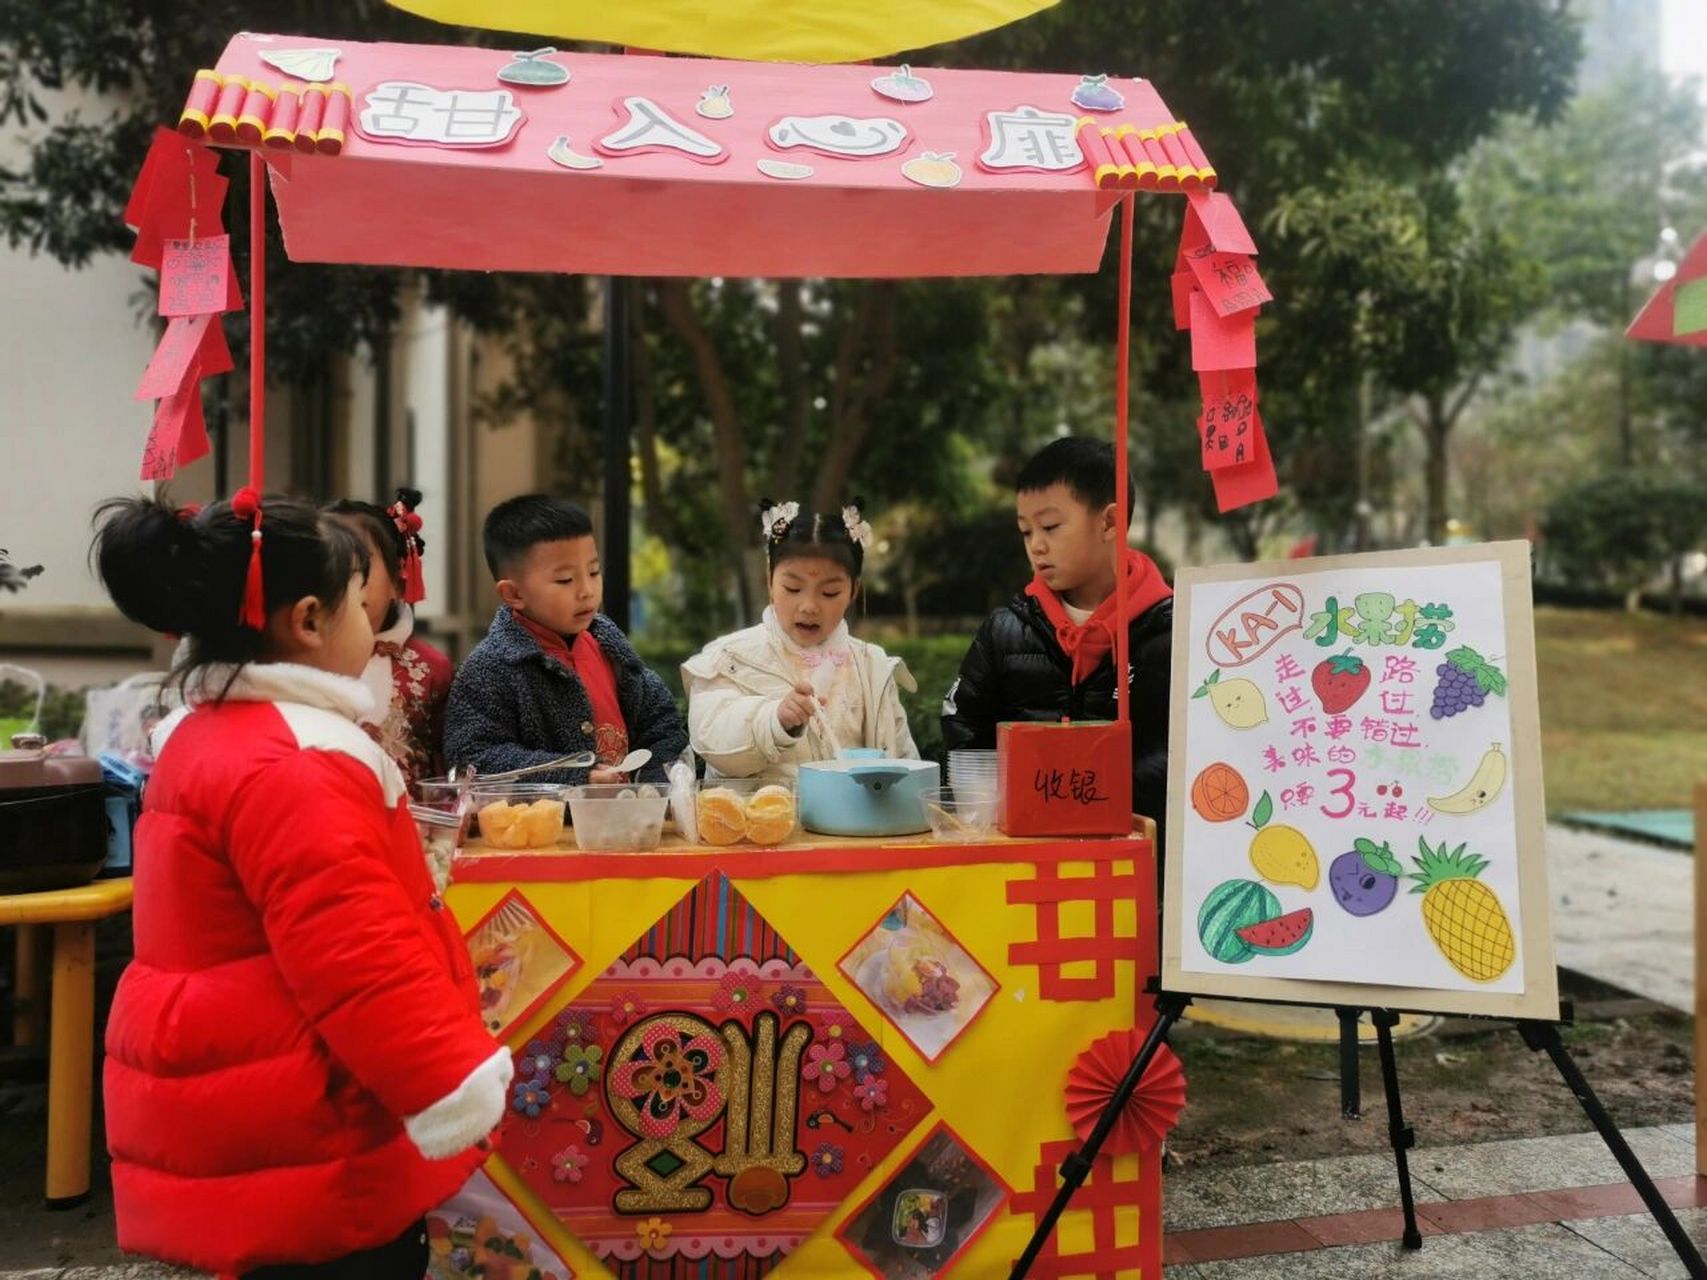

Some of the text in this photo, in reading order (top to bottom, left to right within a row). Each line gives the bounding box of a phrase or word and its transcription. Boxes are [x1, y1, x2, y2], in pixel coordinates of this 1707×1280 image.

[1303, 591, 1456, 650] 水果捞
[1033, 767, 1112, 806] 收银
